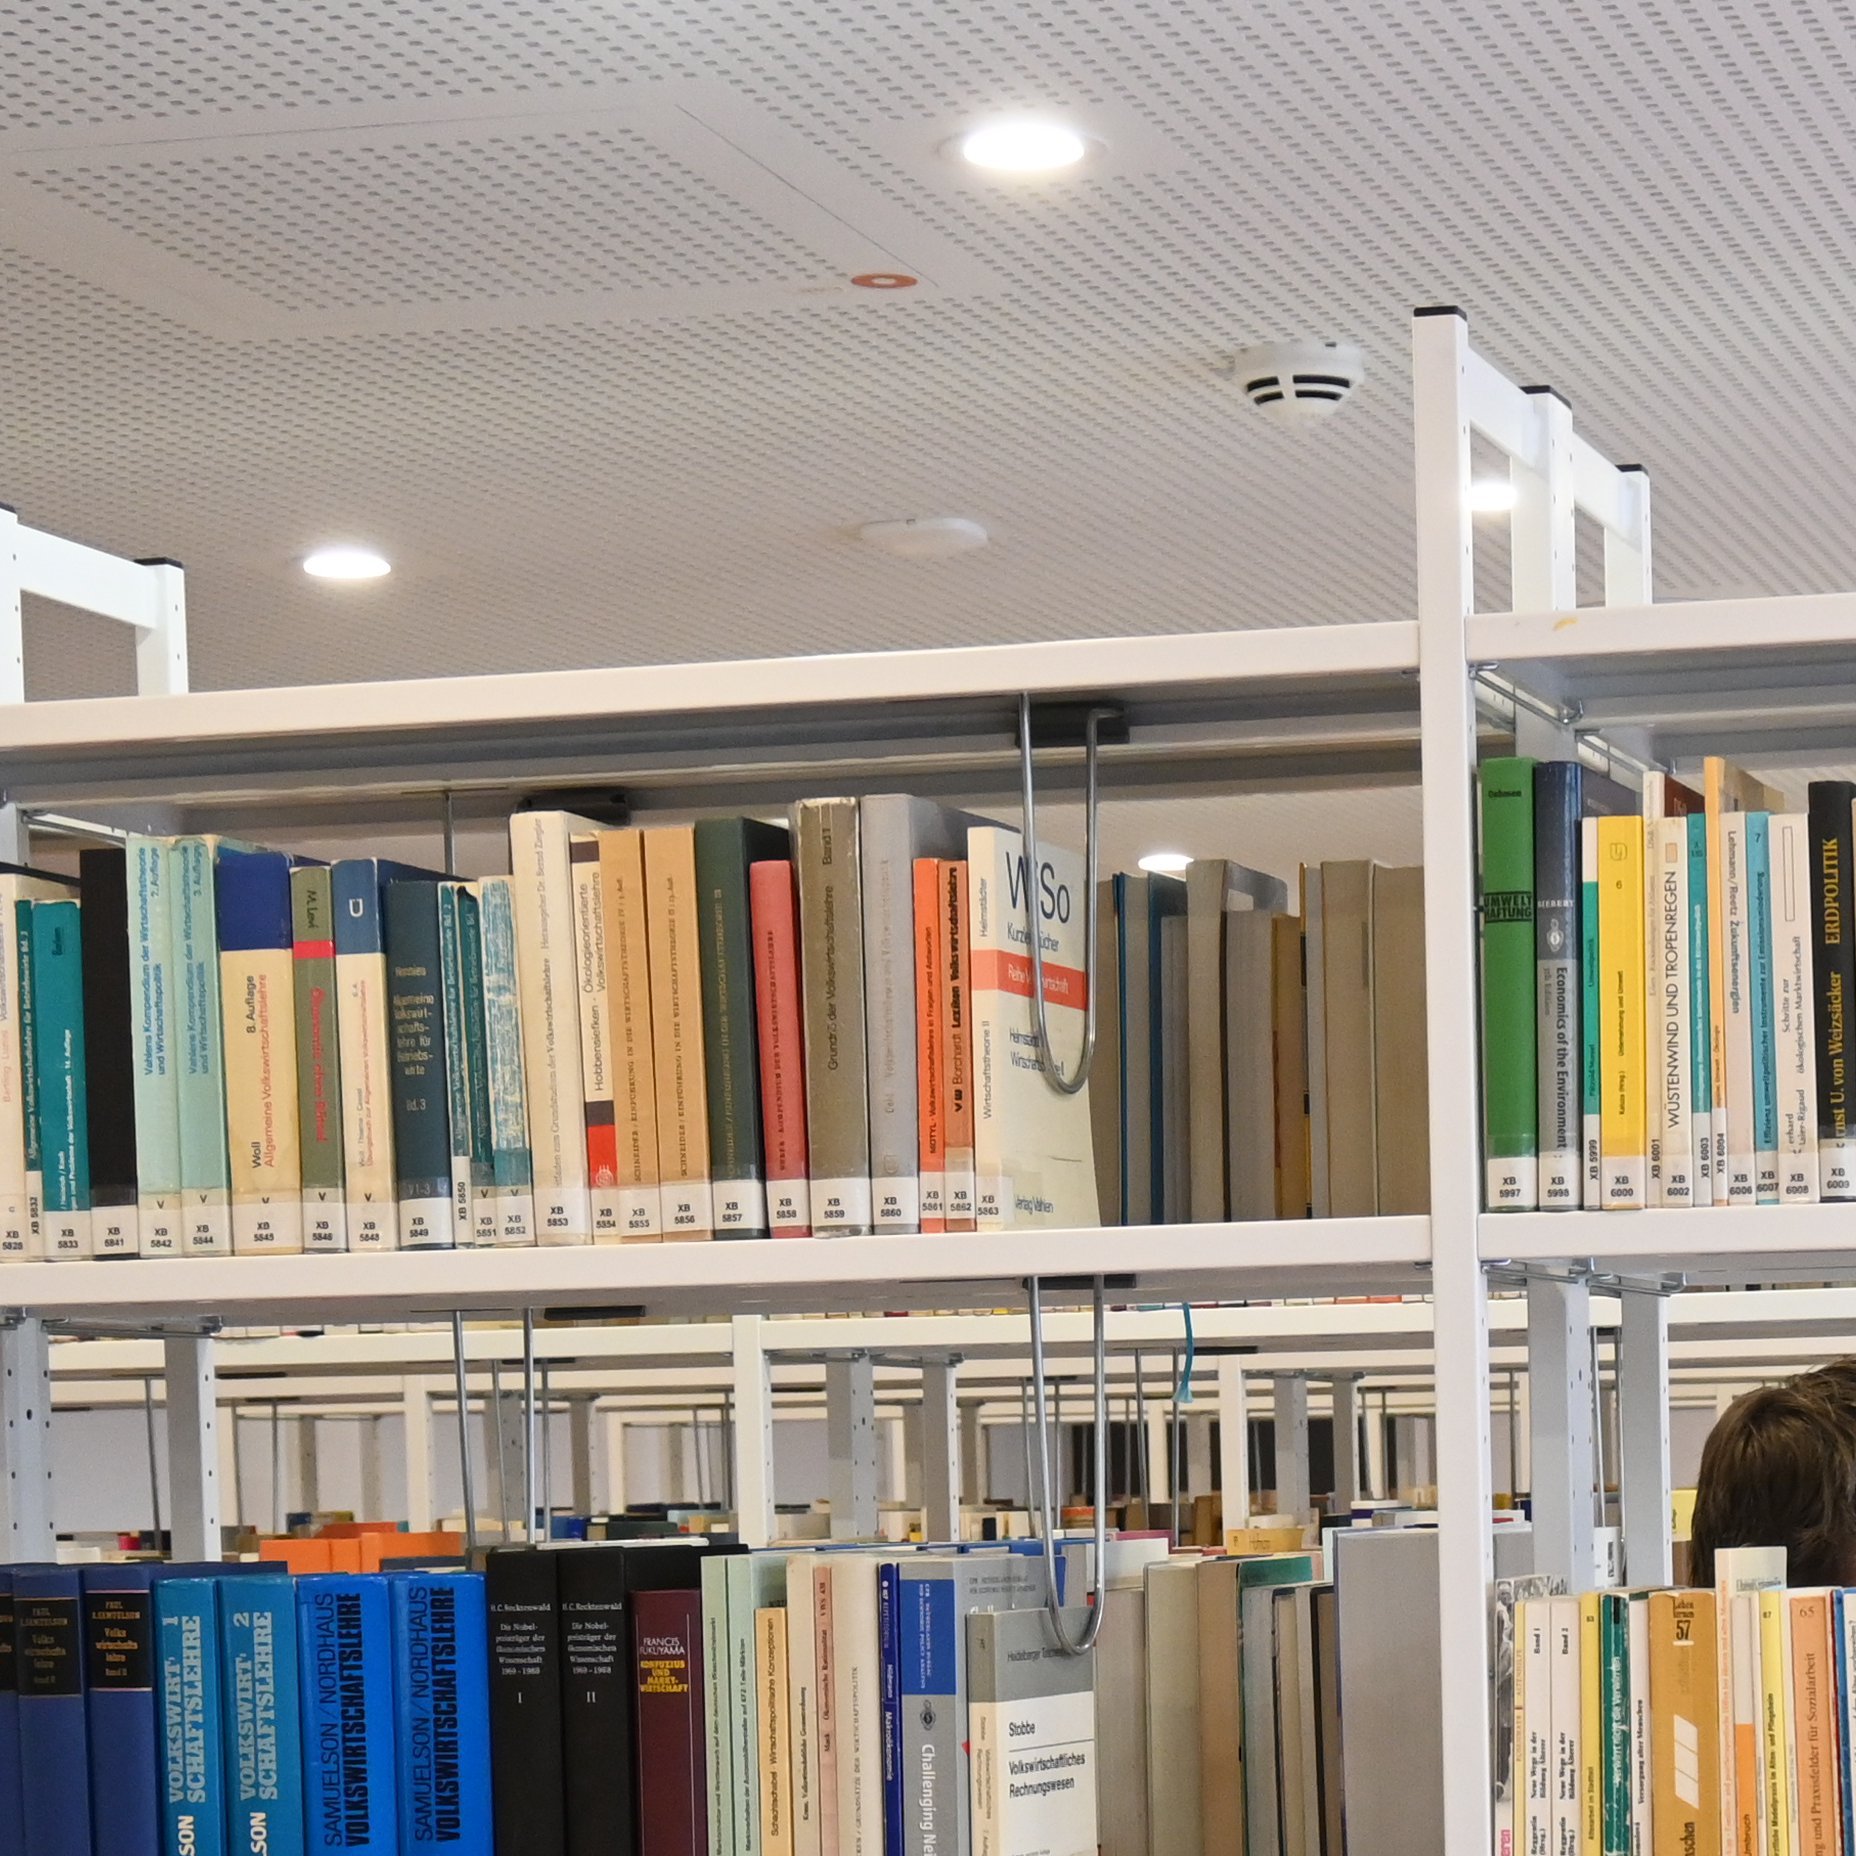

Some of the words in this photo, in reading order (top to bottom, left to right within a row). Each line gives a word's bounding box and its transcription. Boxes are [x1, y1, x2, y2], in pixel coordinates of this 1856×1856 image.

[1822, 838, 1841, 945] ERDPOLITIK
[1664, 872, 1678, 984] TROPENREGEN
[246, 975, 256, 1020] Auflage
[1556, 967, 1568, 1022] Economics
[1665, 988, 1680, 1020] UND
[1826, 971, 1843, 1049] Weizsäcker
[1556, 1025, 1567, 1038] of
[1556, 1041, 1566, 1064] the
[1665, 1022, 1681, 1128] WÜSTENWIND
[1830, 1052, 1843, 1086] von
[261, 1102, 275, 1167] Allgemeine
[1556, 1067, 1567, 1149] Environment
[252, 1141, 262, 1168] Woll
[314, 1592, 338, 1704] NORDHAUS
[408, 1586, 430, 1698] NORDHAUS
[1676, 1620, 1691, 1641] 57
[182, 1615, 206, 1803] SCHAFTSLEHRE
[252, 1611, 278, 1800] SCHAFTSLEHRE
[336, 1592, 370, 1848] VOLKSWIRTSCHAFTSLEHRE
[430, 1587, 461, 1842] VOLKSWIRTSCHAFTSLEHRE
[1806, 1652, 1818, 1722] Sozialarbeit
[1008, 1720, 1036, 1738] Stobbe
[1808, 1727, 1818, 1746] für
[319, 1723, 343, 1848] SAMUELSON
[411, 1718, 434, 1844] SAMUELSON
[919, 1744, 936, 1829] Challenging
[1008, 1777, 1075, 1799] Rechnungswesen
[1811, 1750, 1821, 1817] Praxisfelder
[1813, 1818, 1822, 1842] und
